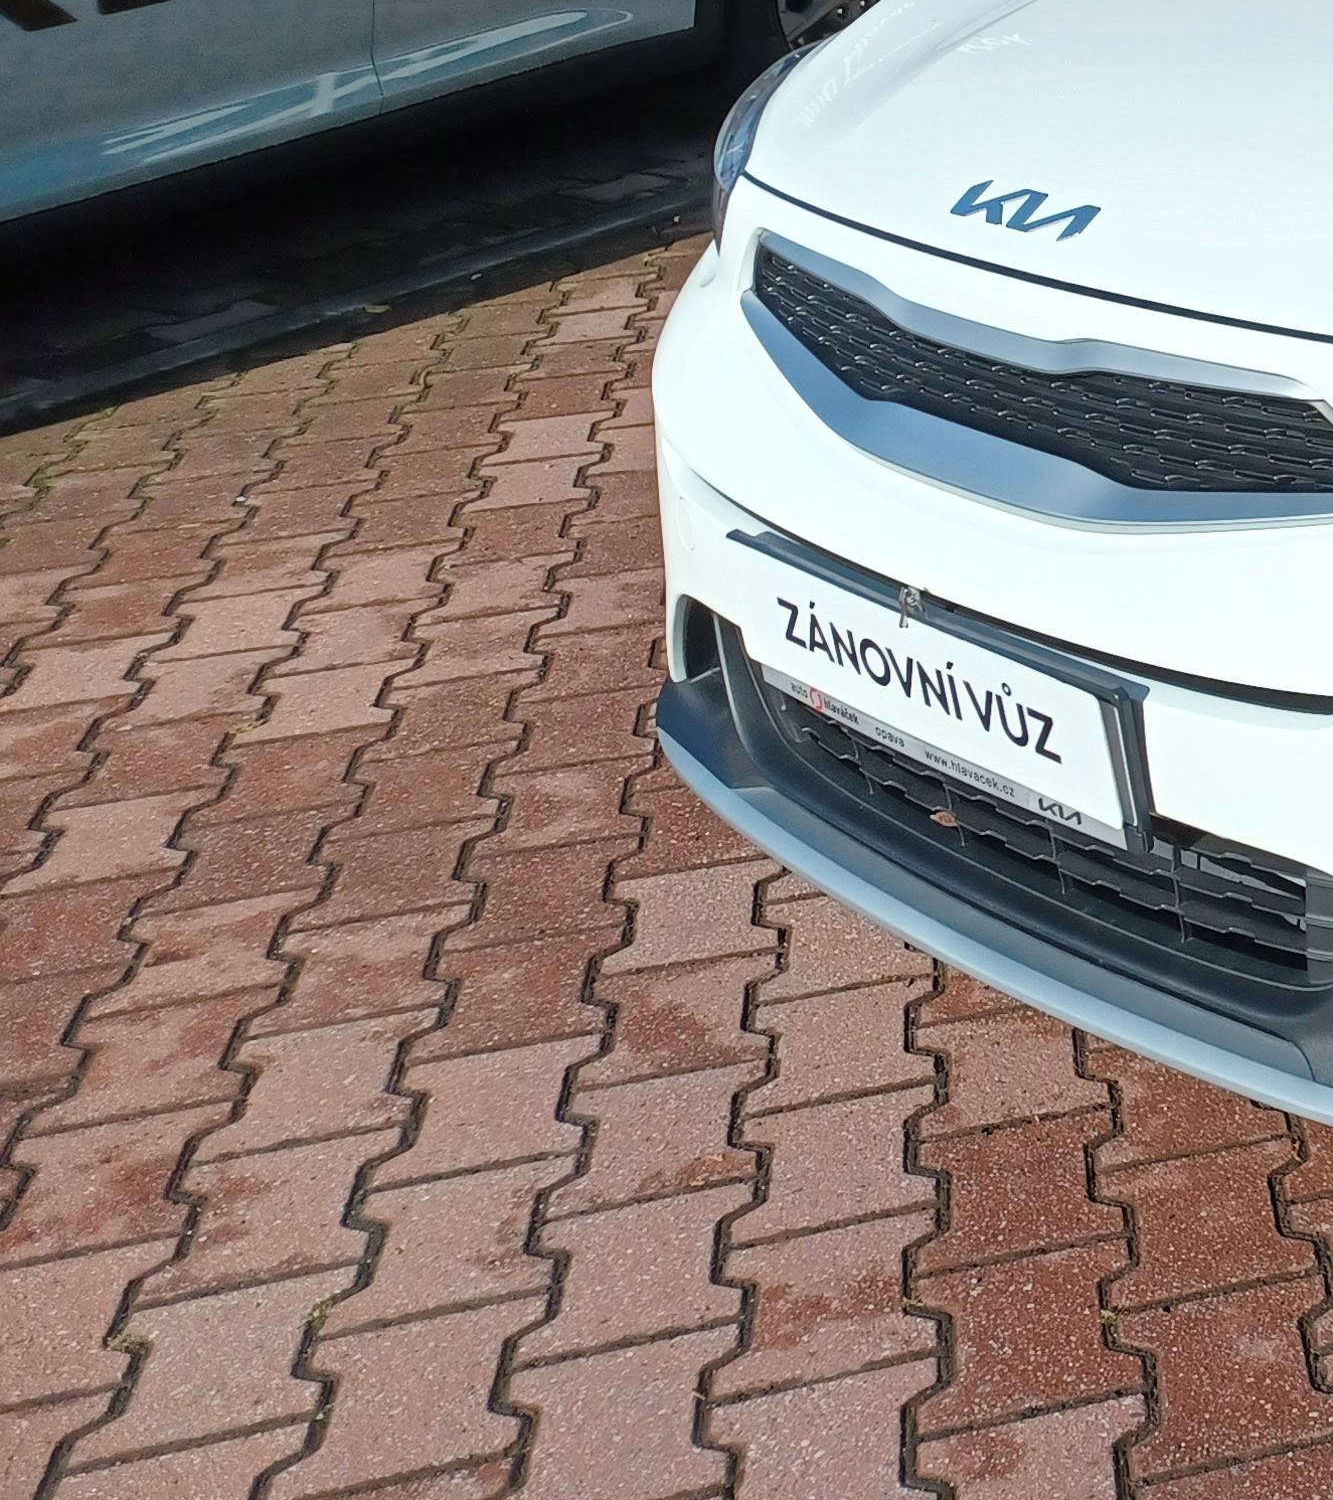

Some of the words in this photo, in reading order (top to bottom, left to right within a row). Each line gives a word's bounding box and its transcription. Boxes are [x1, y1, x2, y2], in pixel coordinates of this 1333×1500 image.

[950, 180, 1101, 242] KIA
[776, 596, 963, 721] ZÁNOVNÍ
[963, 682, 1062, 764] VŮZ
[924, 750, 1016, 799] www.hlavacek.cz
[1037, 797, 1082, 826] KIA
